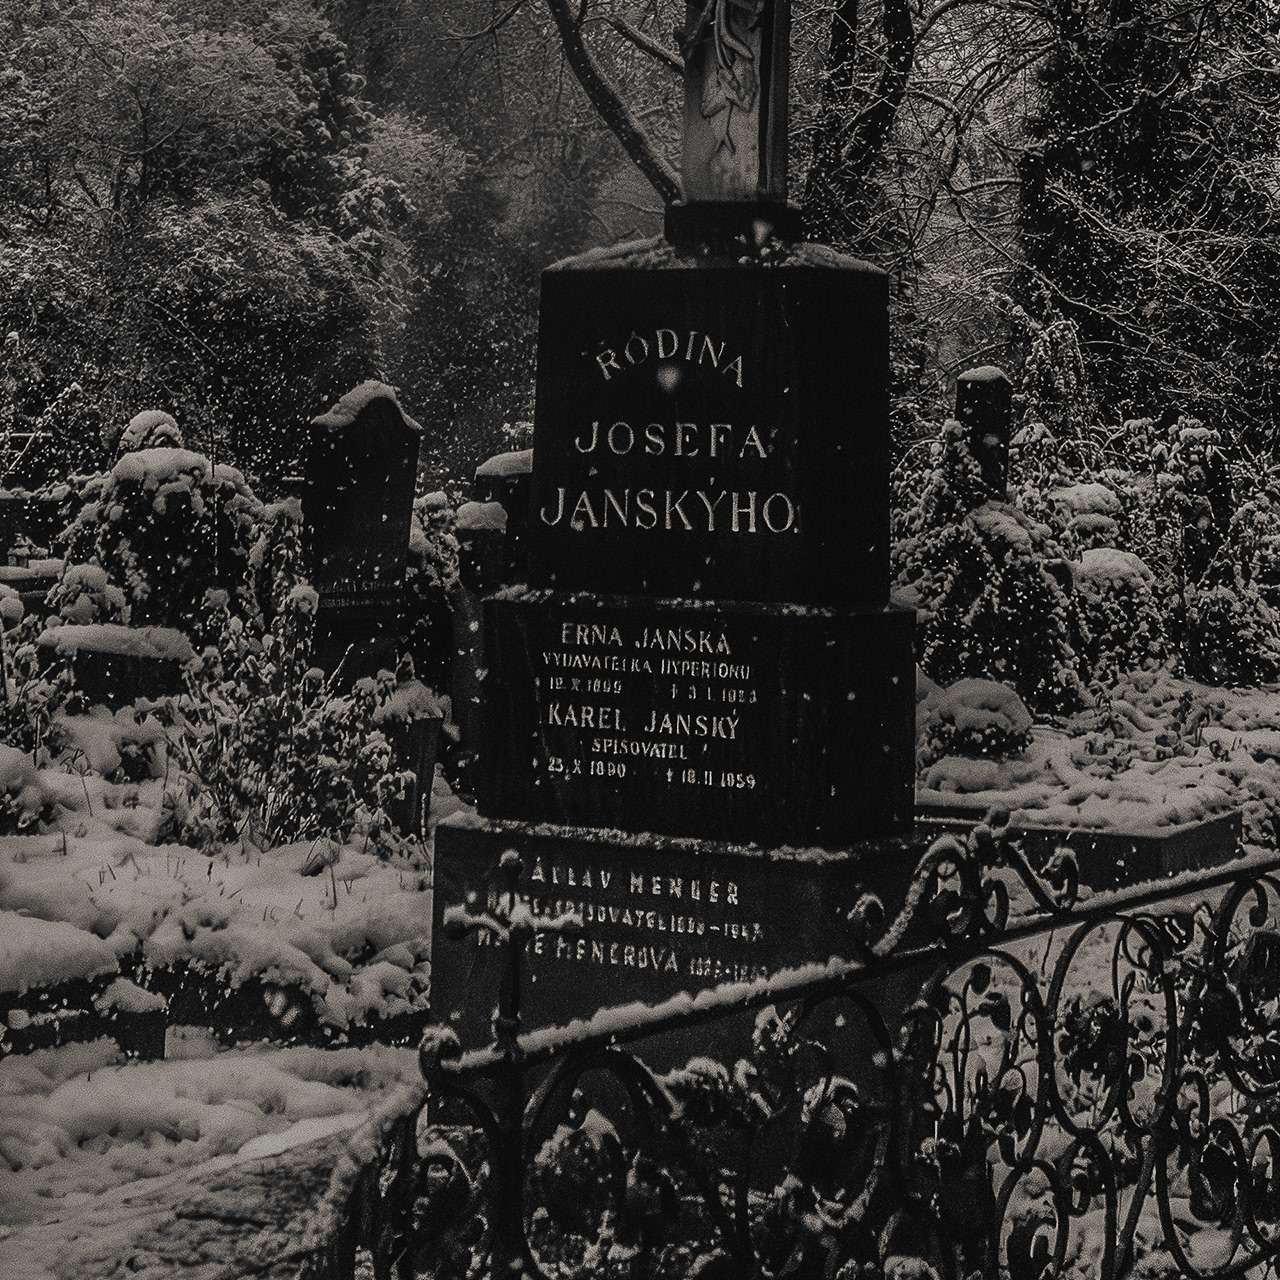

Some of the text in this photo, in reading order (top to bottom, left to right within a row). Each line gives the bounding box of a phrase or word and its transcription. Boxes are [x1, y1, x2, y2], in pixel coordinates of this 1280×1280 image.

[596, 328, 744, 389] RODINA
[574, 421, 769, 458] JOSEFA
[539, 476, 795, 533] JANSKÝHO
[561, 622, 623, 647] ERNA
[547, 702, 741, 740] KAREL JANSKÝ
[591, 738, 689, 761] SPISOVATEL
